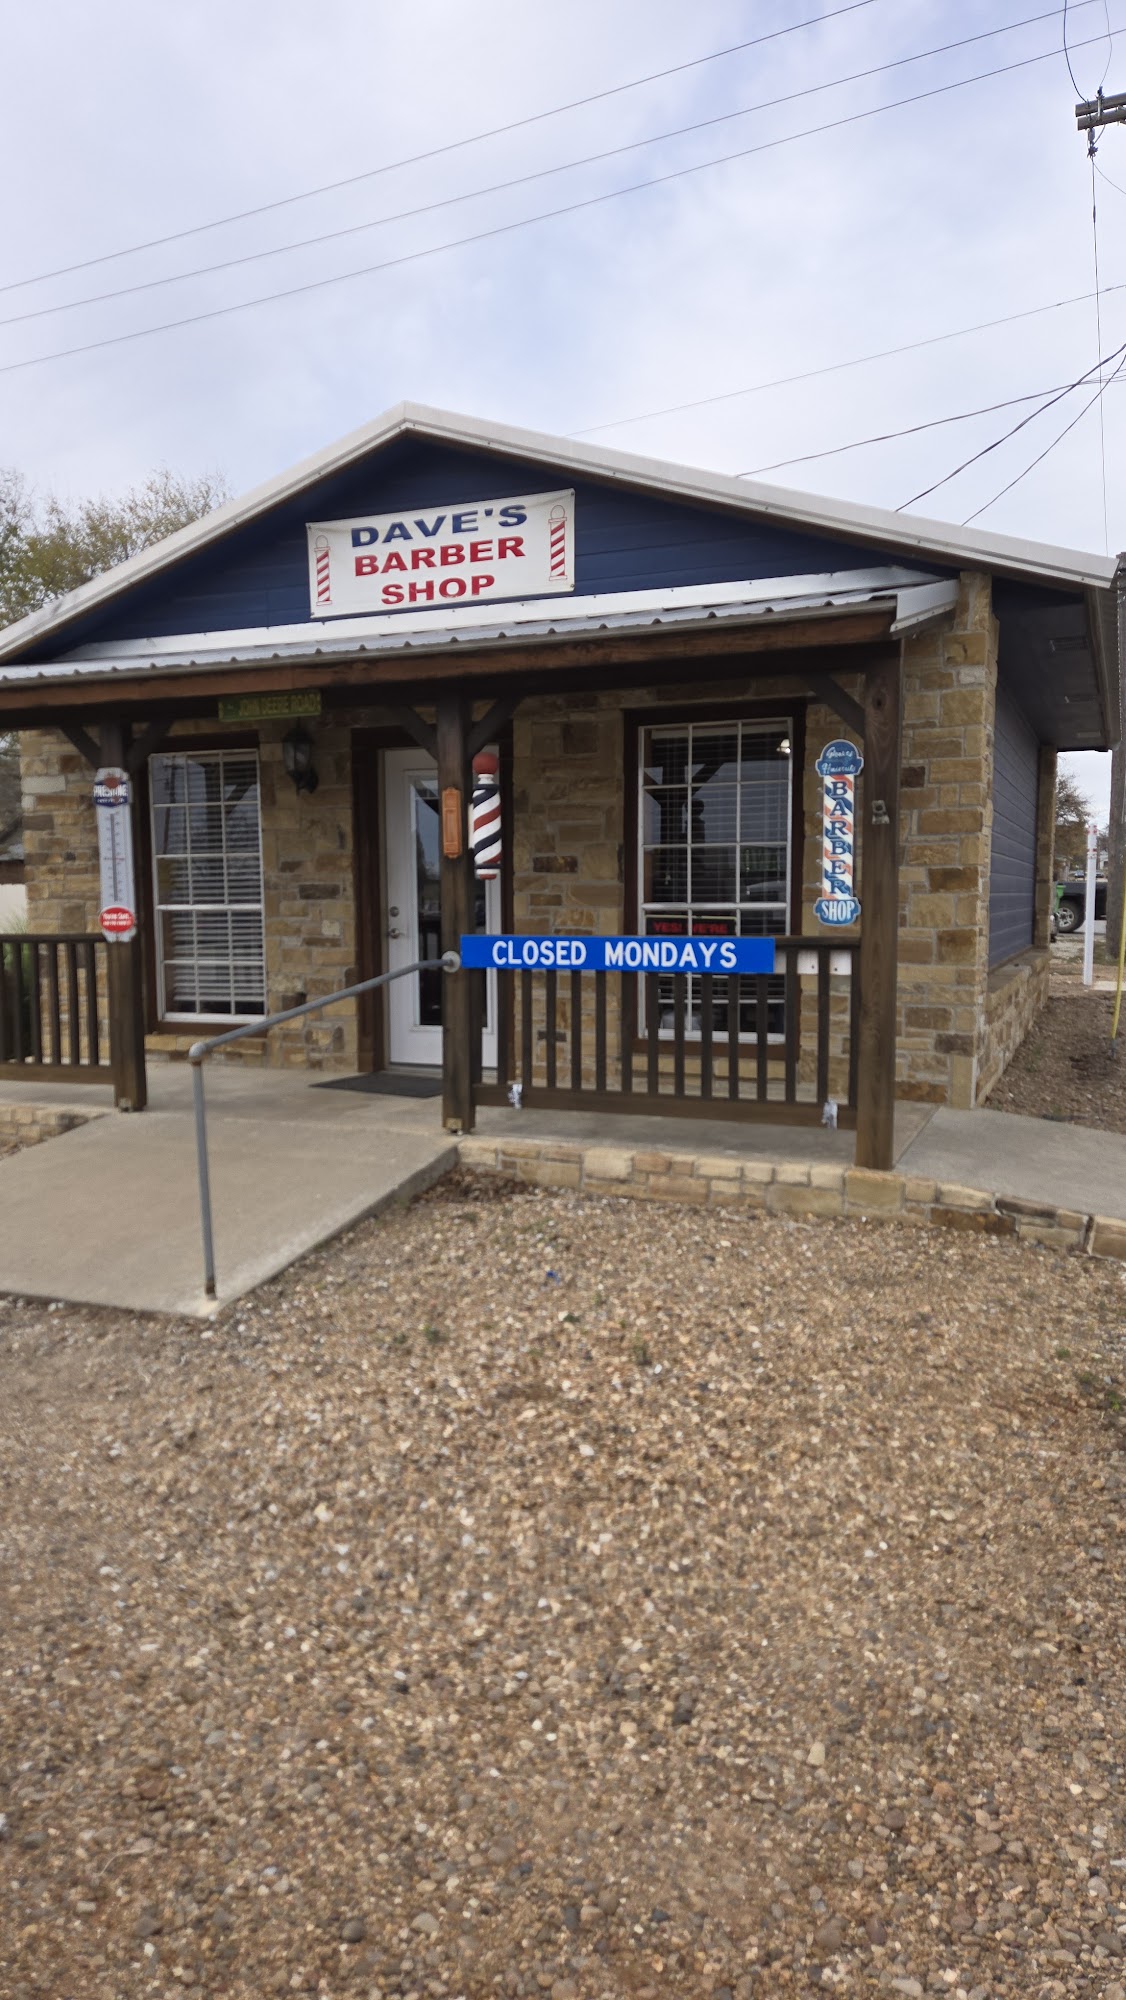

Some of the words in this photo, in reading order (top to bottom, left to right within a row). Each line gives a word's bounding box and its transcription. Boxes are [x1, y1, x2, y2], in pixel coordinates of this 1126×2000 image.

[351, 504, 528, 548] DAVE'S
[354, 535, 526, 577] BARBER
[381, 574, 496, 605] SHOP
[829, 781, 849, 894] BARBER
[821, 900, 856, 921] SHOP
[492, 940, 587, 966] CLOSED
[604, 941, 737, 969] MONDAYS
